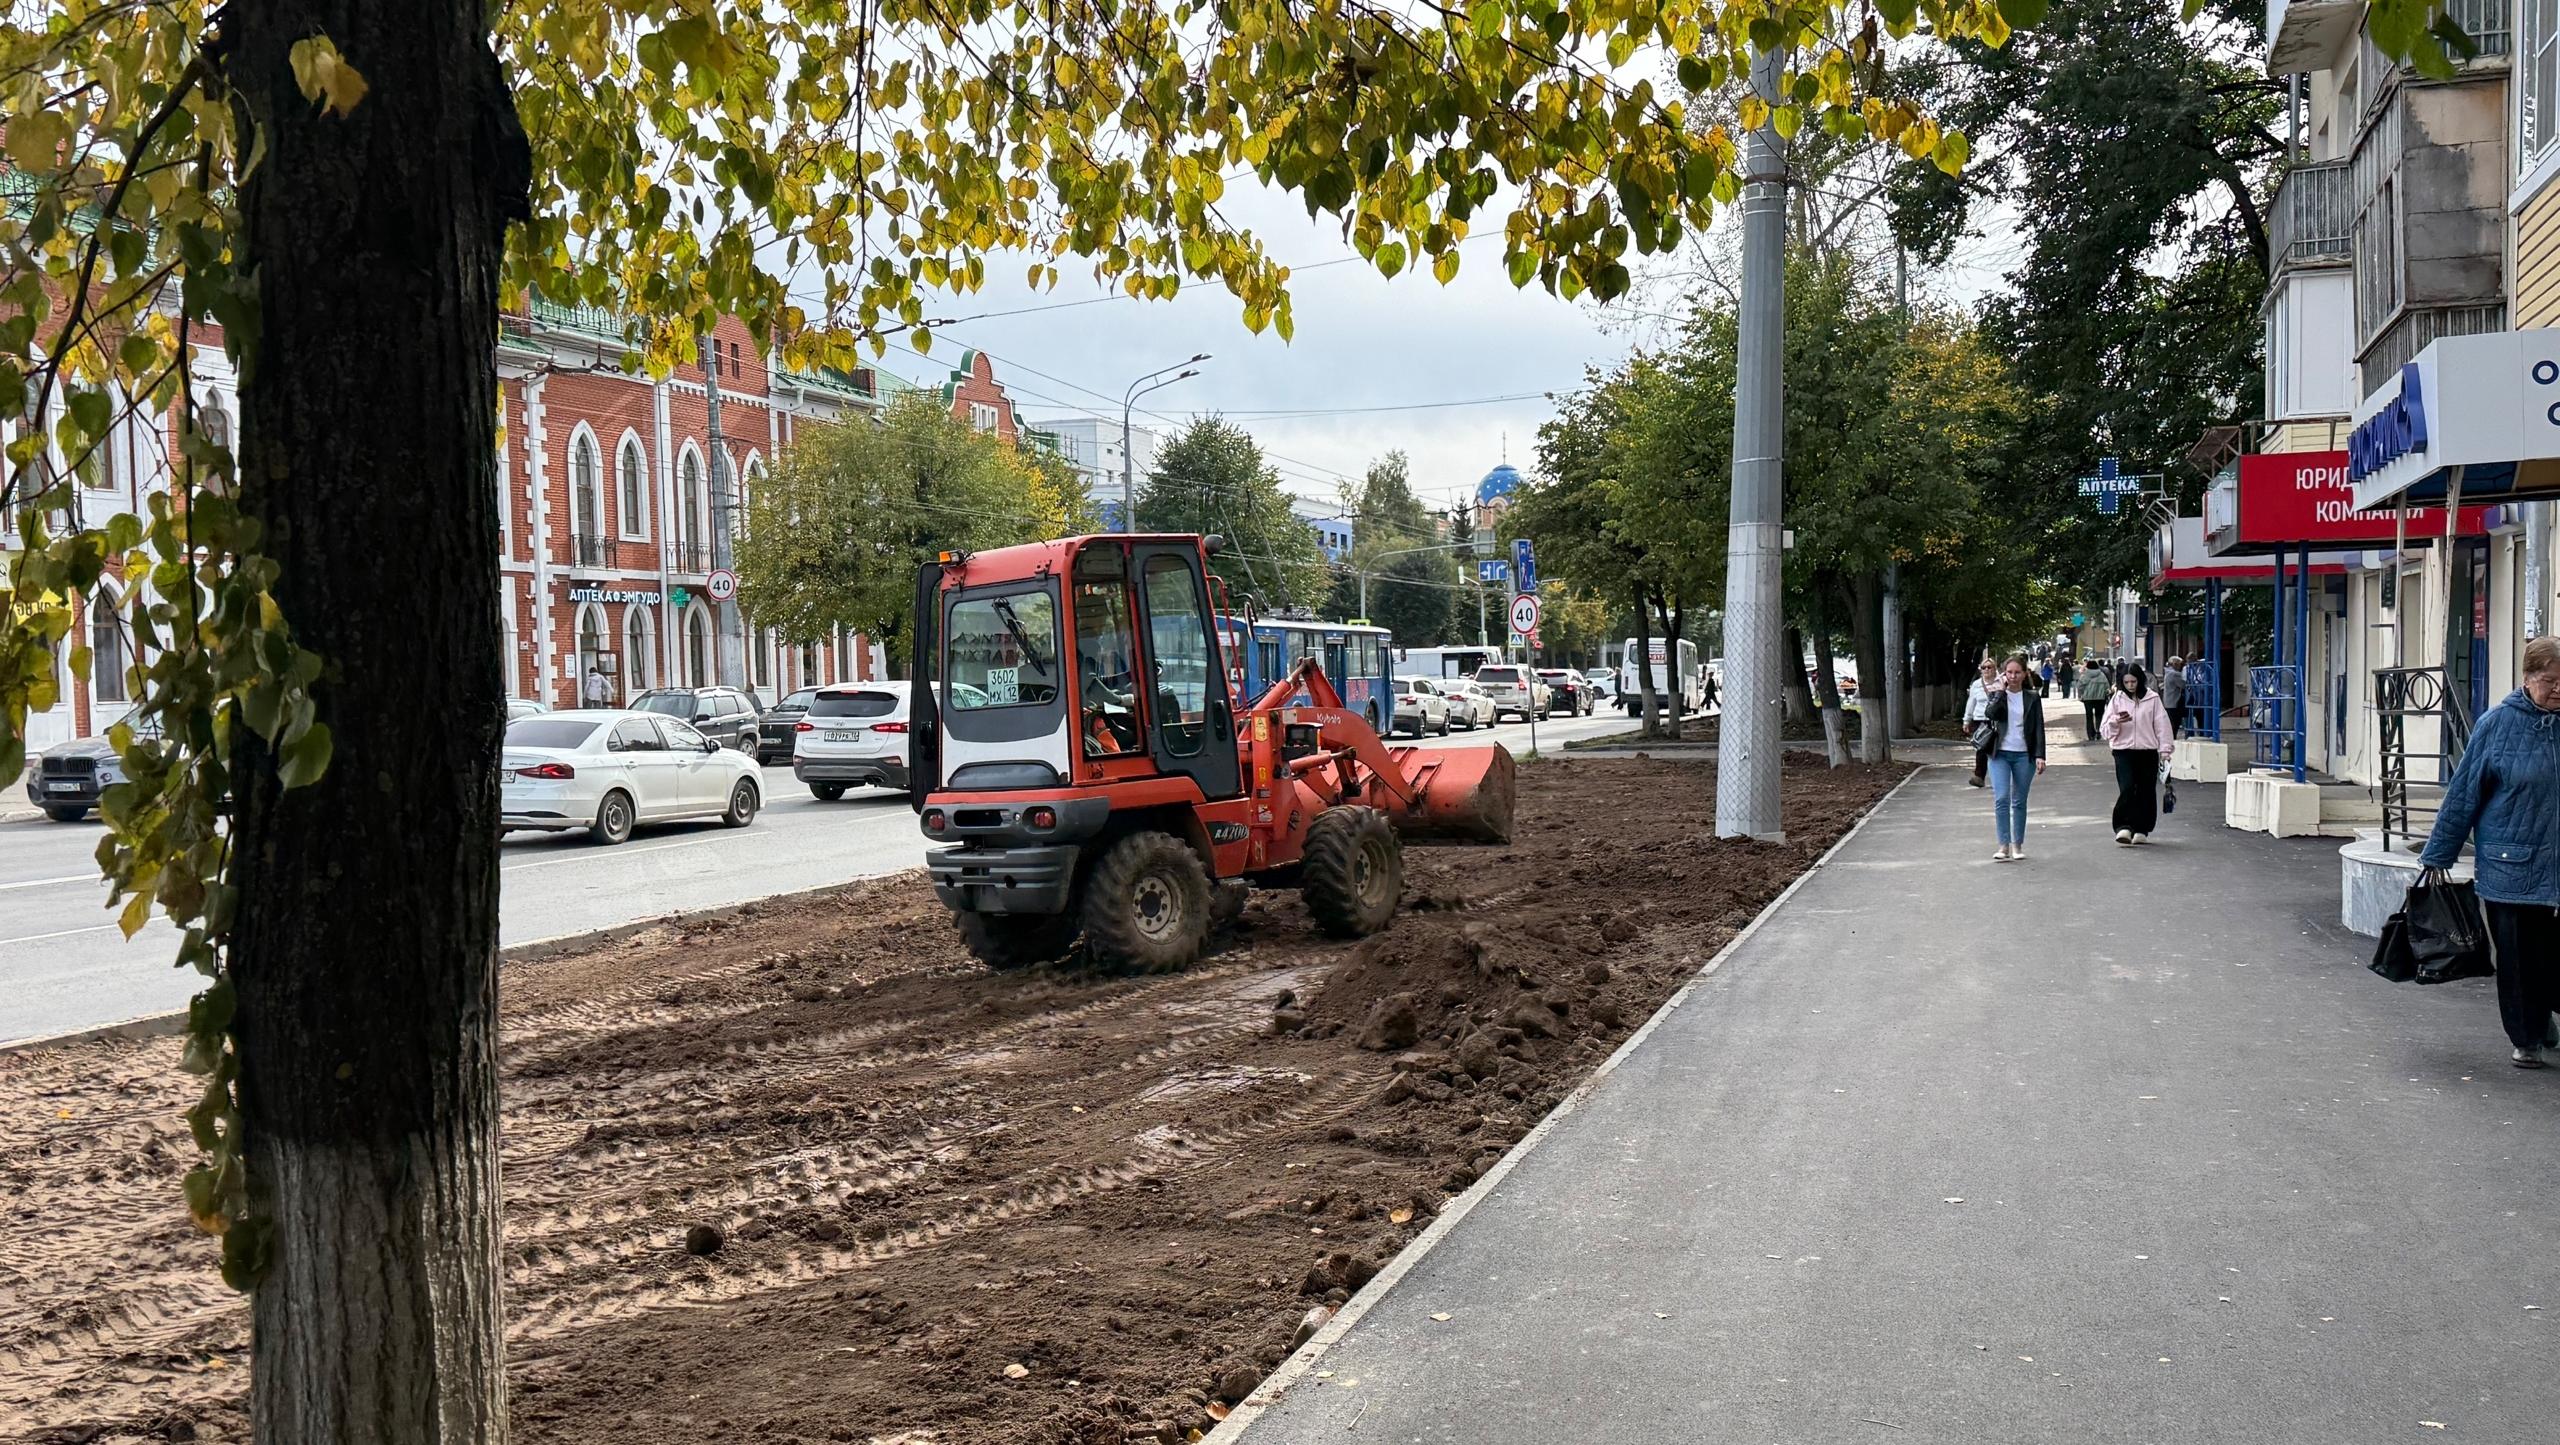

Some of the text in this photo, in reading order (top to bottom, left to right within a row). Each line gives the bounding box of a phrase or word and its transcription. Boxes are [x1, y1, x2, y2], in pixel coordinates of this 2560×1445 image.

[2081, 479, 2137, 492] АПТЕКА
[713, 580, 729, 591] 40
[569, 589, 614, 602] АПТЕКА
[1516, 607, 1533, 622] 40
[991, 669, 1015, 685] 3602
[1007, 686, 1017, 698] 12
